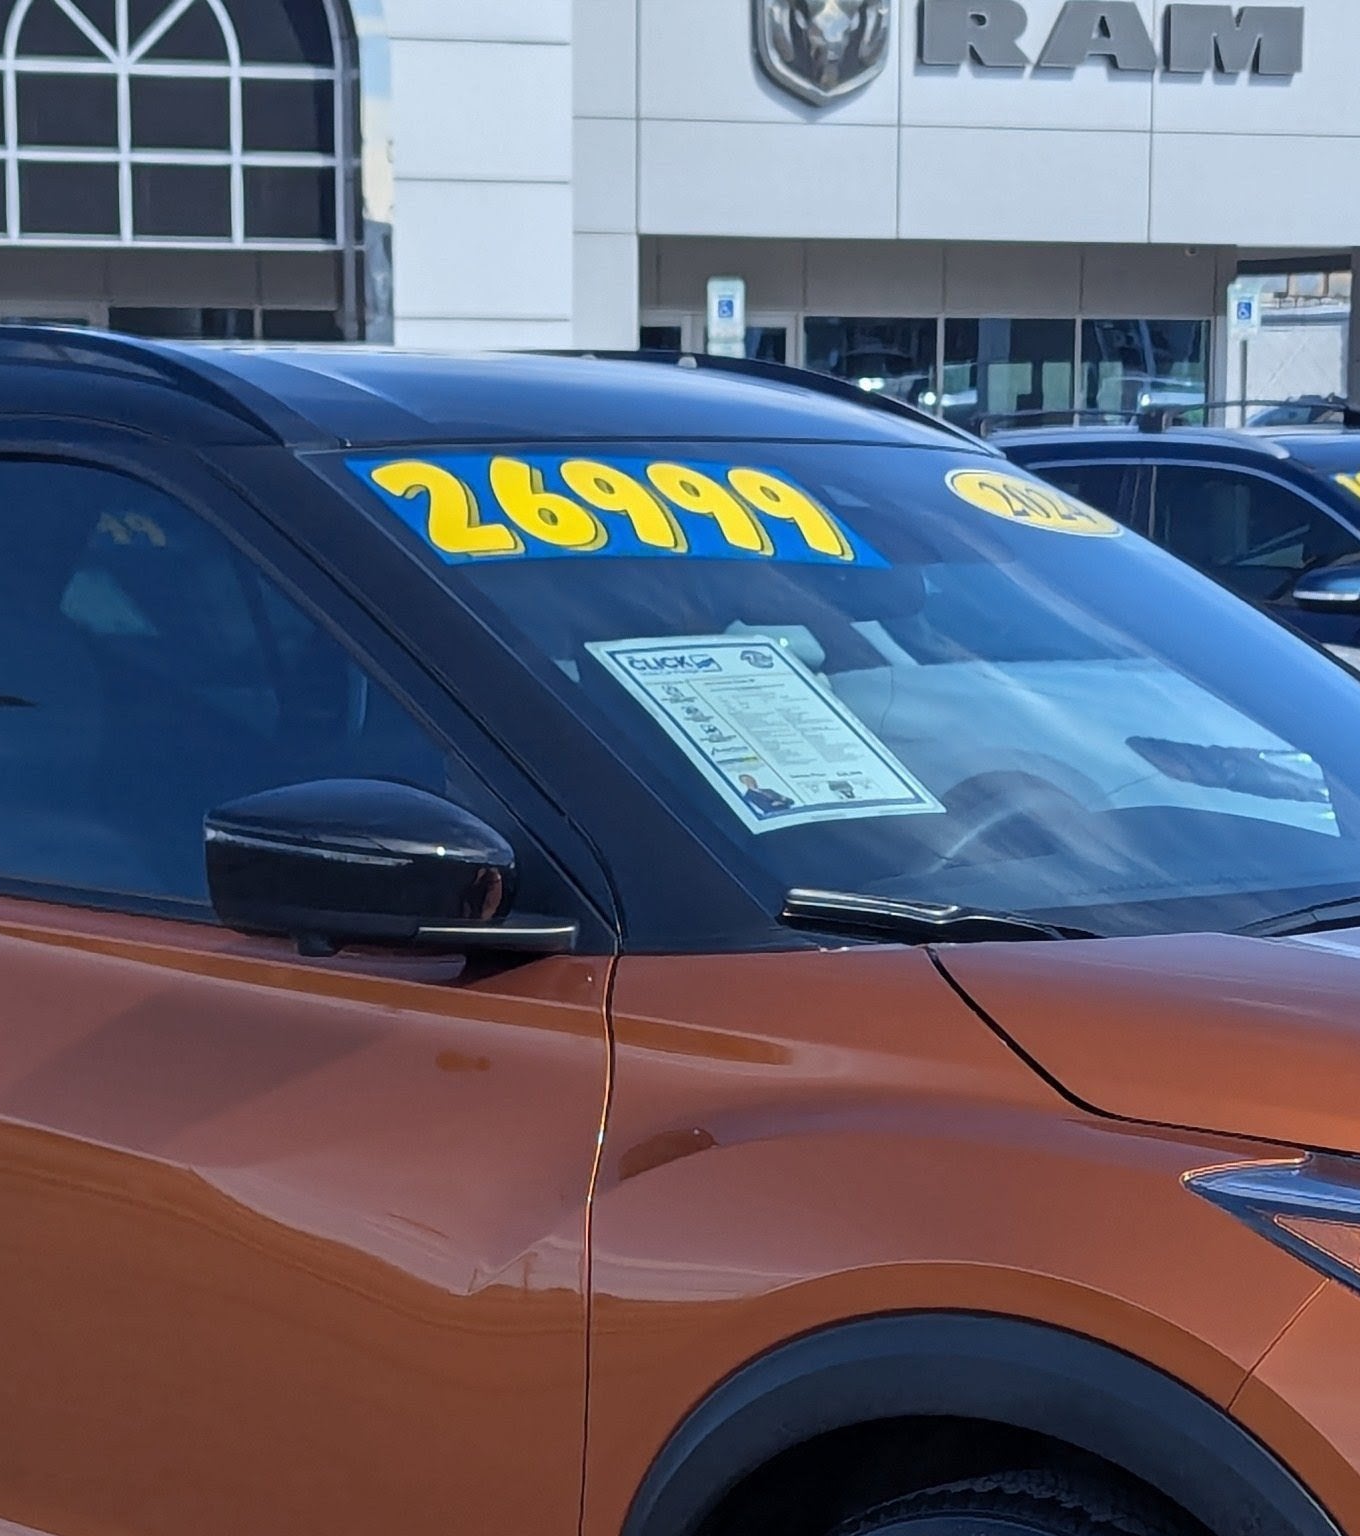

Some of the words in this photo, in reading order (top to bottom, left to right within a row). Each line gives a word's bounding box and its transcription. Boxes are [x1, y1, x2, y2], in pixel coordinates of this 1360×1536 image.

[917, 0, 1305, 75] RAM
[370, 456, 855, 563] 26999
[628, 654, 693, 671] CLICK
